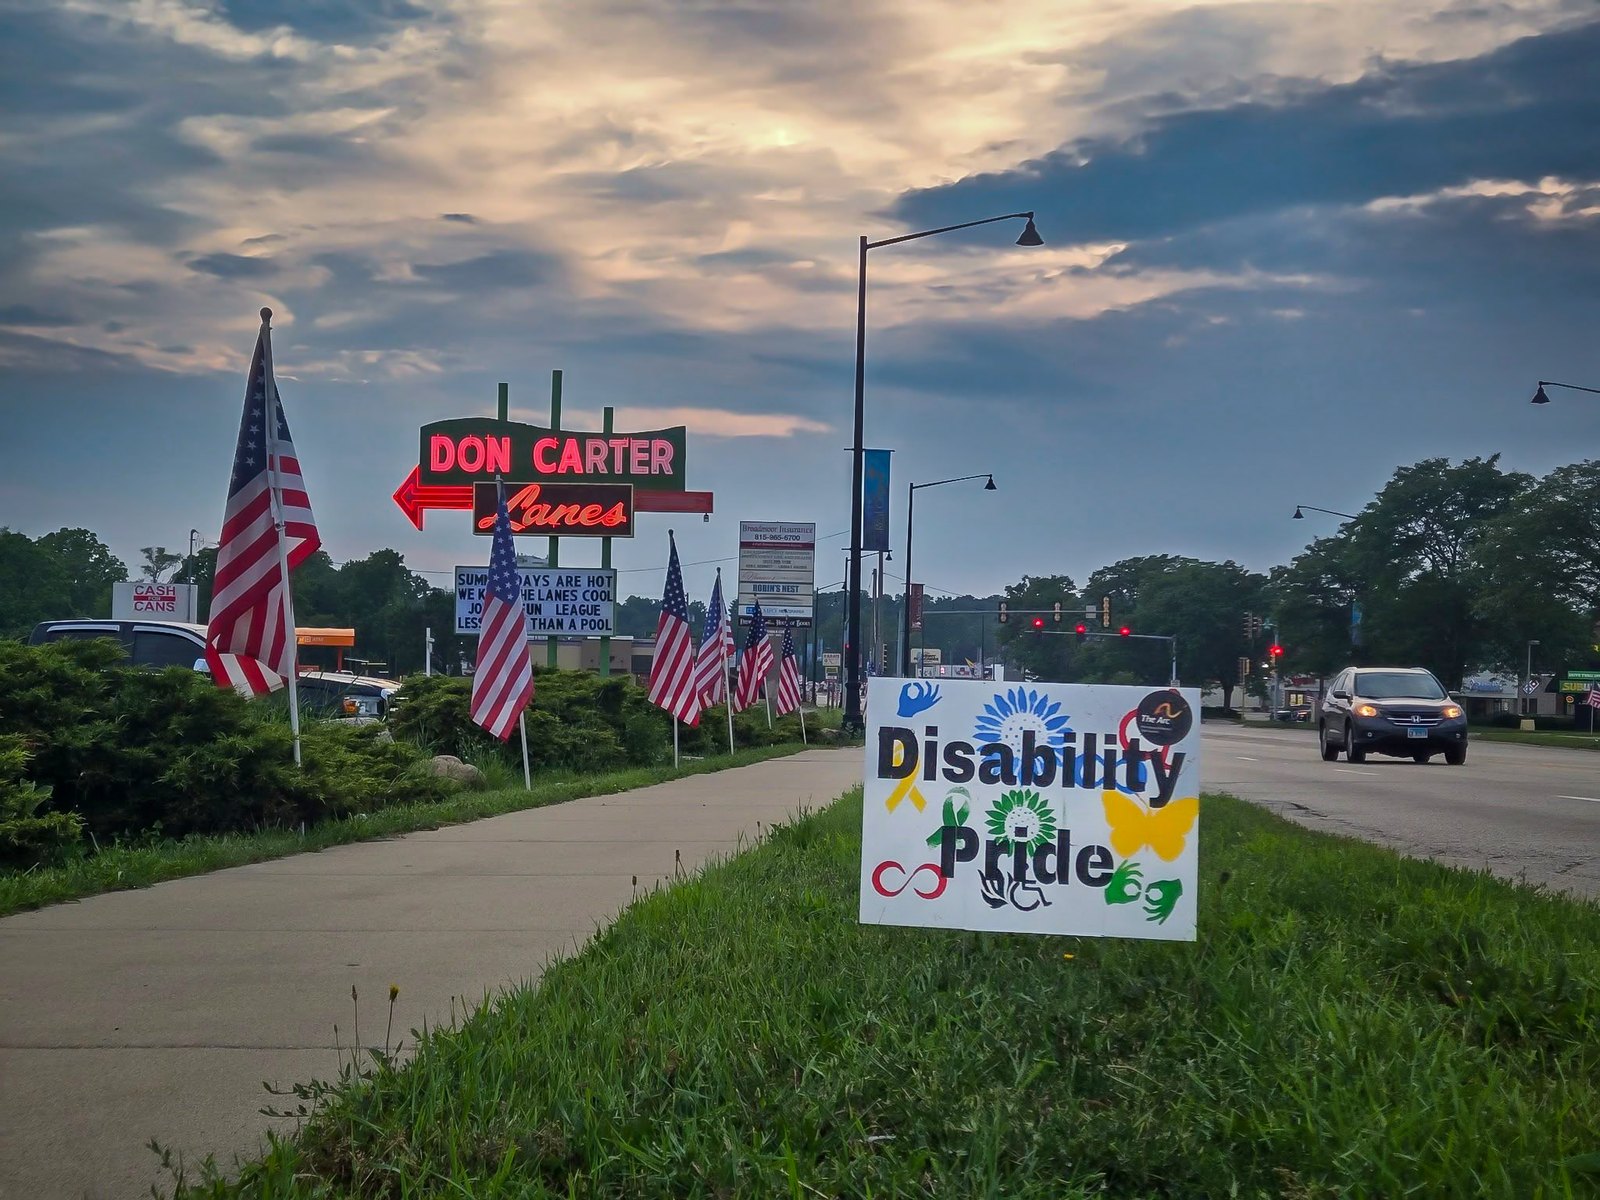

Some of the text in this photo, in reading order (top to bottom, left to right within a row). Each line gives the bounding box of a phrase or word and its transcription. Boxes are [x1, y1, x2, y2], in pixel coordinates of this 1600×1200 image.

[430, 435, 674, 475] DON CARTER
[478, 484, 627, 531] Lanes
[780, 525, 813, 534] Insurance
[458, 573, 489, 586] SUMM
[556, 575, 581, 588] ARE
[587, 575, 613, 588] HOT
[134, 585, 176, 595] CASH
[458, 588, 475, 600] WE
[520, 589, 535, 601] HE
[538, 589, 578, 602] LANES
[582, 589, 613, 602] COOL
[753, 584, 800, 593] ROBIN'S NEST
[134, 601, 175, 612] CANS
[555, 603, 601, 616] LEAGUE
[530, 617, 564, 630] THAN
[568, 618, 577, 630] A
[580, 618, 612, 631] POOL
[1141, 714, 1171, 724] The Arc
[877, 726, 1187, 809] Disability
[940, 825, 1114, 888] Pride
